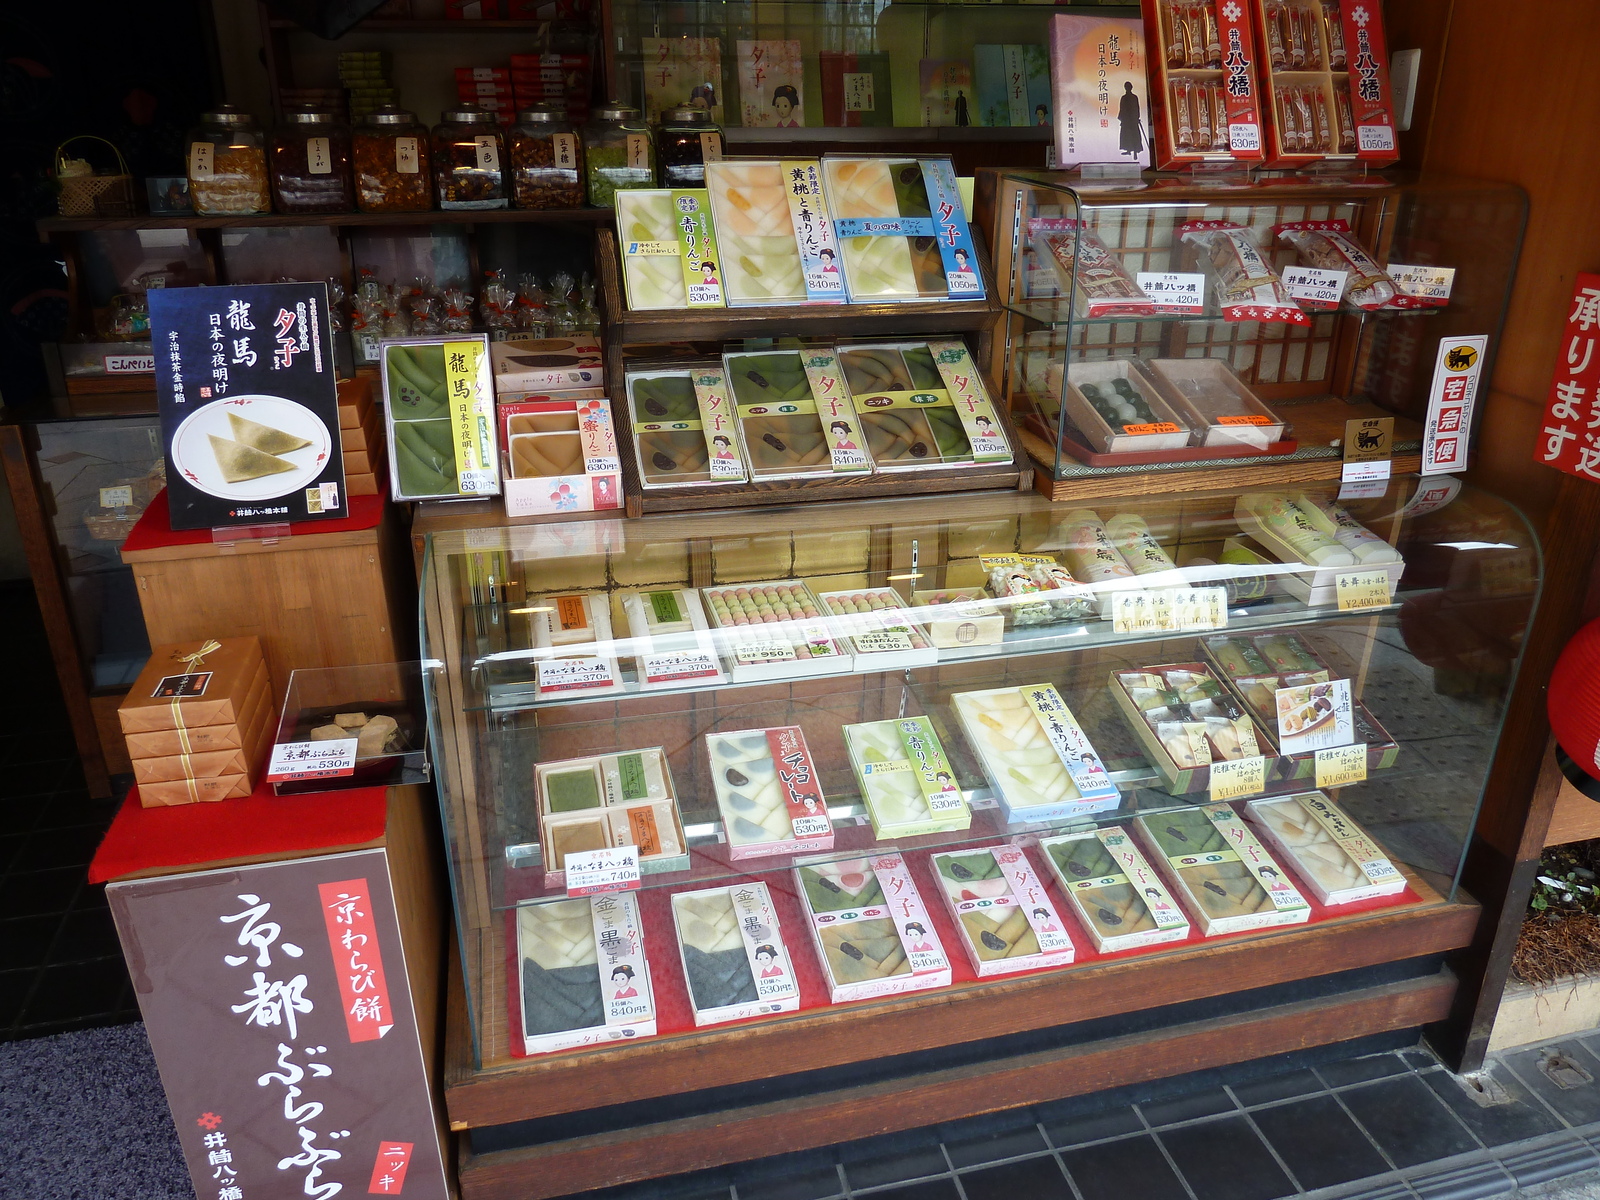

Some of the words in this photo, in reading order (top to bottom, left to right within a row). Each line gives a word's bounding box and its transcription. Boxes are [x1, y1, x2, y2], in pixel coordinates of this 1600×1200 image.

[1107, 34, 1121, 66] 龍馬
[1012, 72, 1022, 99] 夕子
[1098, 43, 1108, 116] 日本の夜明け
[197, 147, 207, 171] はっか
[480, 139, 493, 163] 五色
[807, 165, 820, 195] 季節限定
[790, 168, 819, 257] 黄桃と青りんご
[863, 221, 901, 232] 夏の四味
[937, 201, 961, 246] 夕子
[680, 216, 700, 272] 青りんご
[1176, 295, 1199, 304] 420円
[1314, 290, 1337, 300] 420円
[226, 300, 257, 367] 龍馬
[274, 307, 300, 368] 夕子
[168, 330, 185, 404] 宇治抹茶金時餡
[209, 313, 229, 394] 日本の夜明け
[449, 352, 470, 399] 龍馬
[1544, 287, 1600, 461] 承ります
[706, 394, 726, 431] 夕子
[818, 376, 844, 417] 夕子
[867, 398, 890, 406] ニッキ
[914, 395, 934, 403] 抹茶
[952, 374, 980, 413] 夕子
[459, 404, 472, 458] 日本の夜明け
[582, 420, 600, 457] 蜜りんご
[1435, 378, 1466, 462] 宅急便
[688, 663, 714, 671] 370円
[284, 748, 345, 761] 京都ぶらぶら
[319, 759, 350, 769] 530円
[908, 735, 936, 782] 青りんご
[1230, 827, 1260, 863] 夕子
[610, 871, 637, 880] 740円
[1122, 852, 1148, 884] 夕子
[888, 876, 915, 918] 夕子
[1014, 871, 1039, 905] 夕子
[328, 893, 383, 1022] 京わらび餅
[219, 893, 351, 1196] 京都ぶらぶら
[379, 1146, 405, 1191] ニッキ
